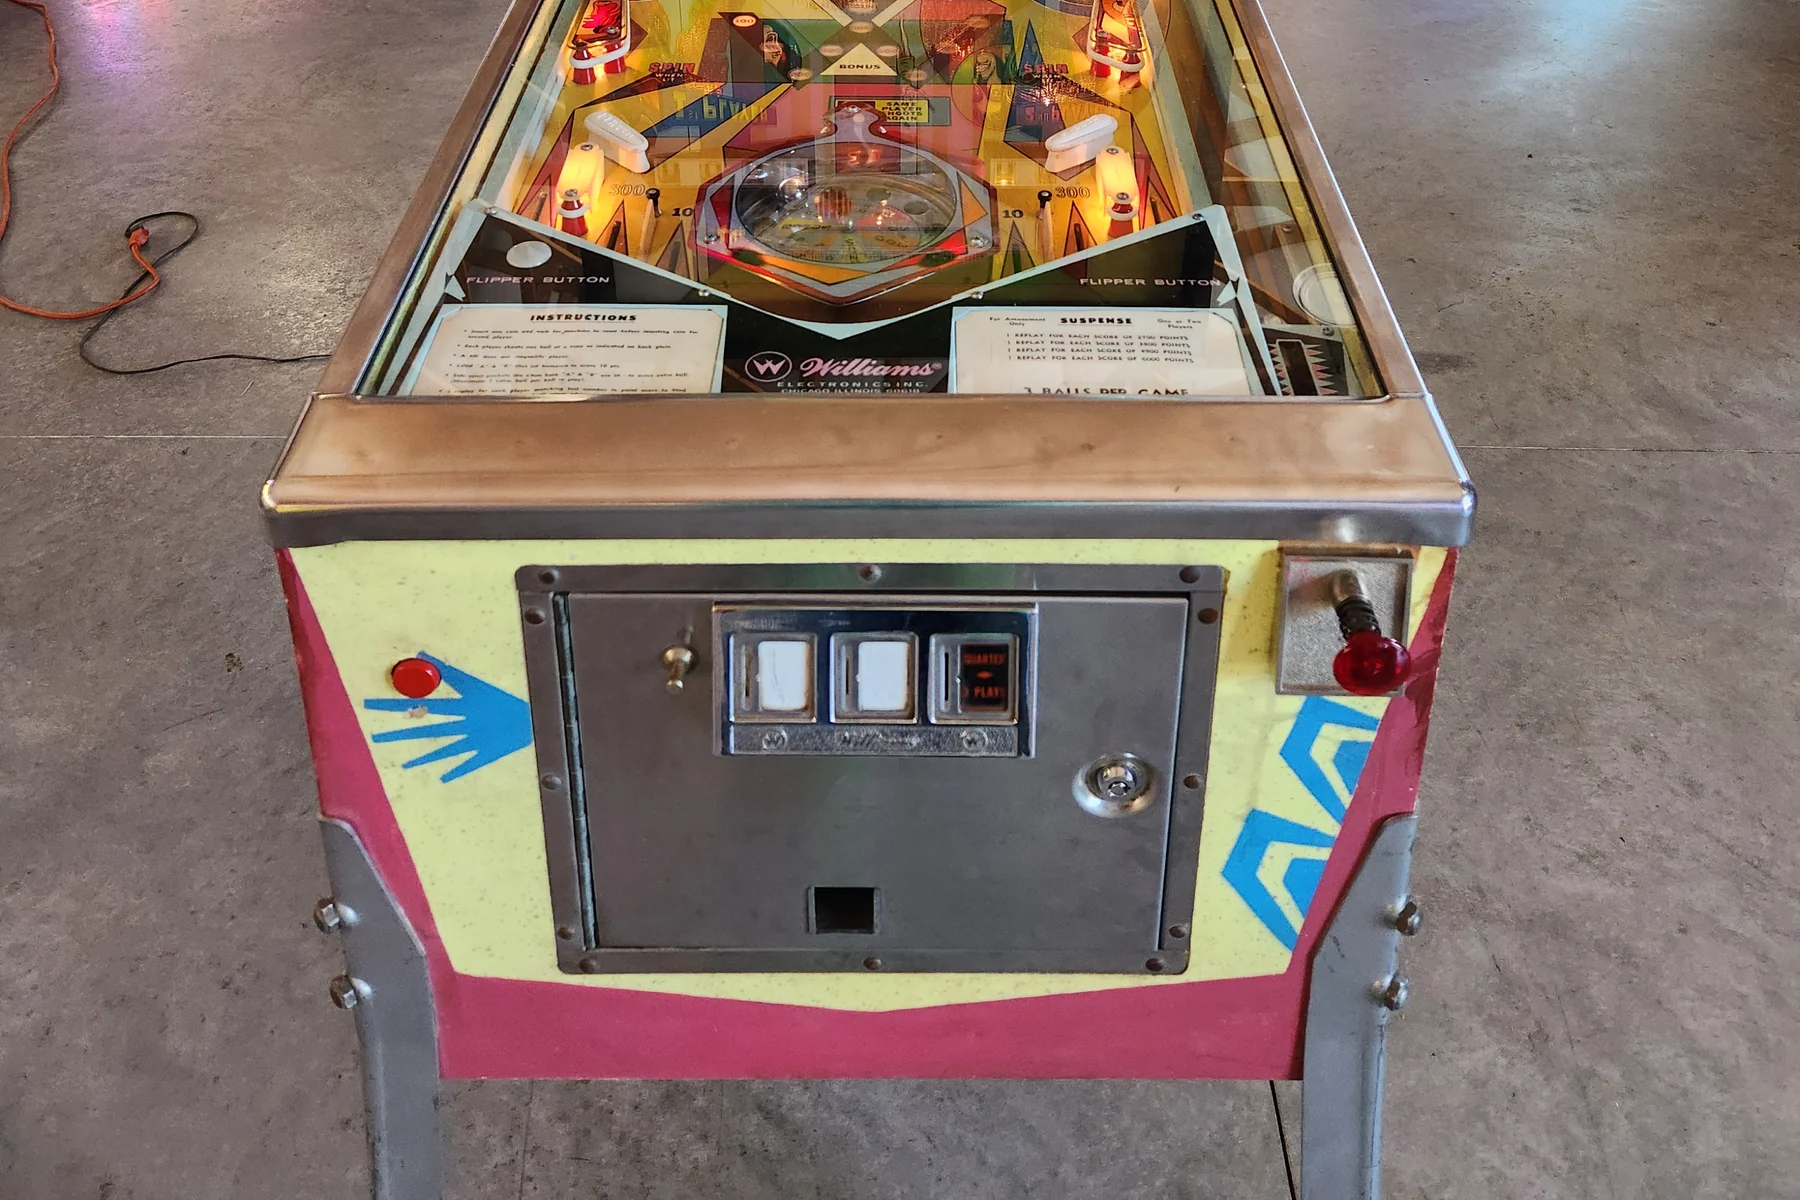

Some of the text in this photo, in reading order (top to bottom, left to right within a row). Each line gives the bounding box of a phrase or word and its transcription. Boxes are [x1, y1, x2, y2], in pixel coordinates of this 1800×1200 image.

[649, 62, 696, 73] SPIN
[1024, 63, 1069, 74] SPIN
[608, 183, 646, 197] 300
[1054, 186, 1091, 199] 300
[671, 207, 694, 217] 10
[1002, 209, 1024, 219] 10
[466, 276, 610, 284] FLIPPER BUTTON
[1079, 278, 1221, 286] FLIPPER BUTTON
[530, 313, 637, 321] INSTRUCTIONS
[800, 357, 935, 378] Williams
